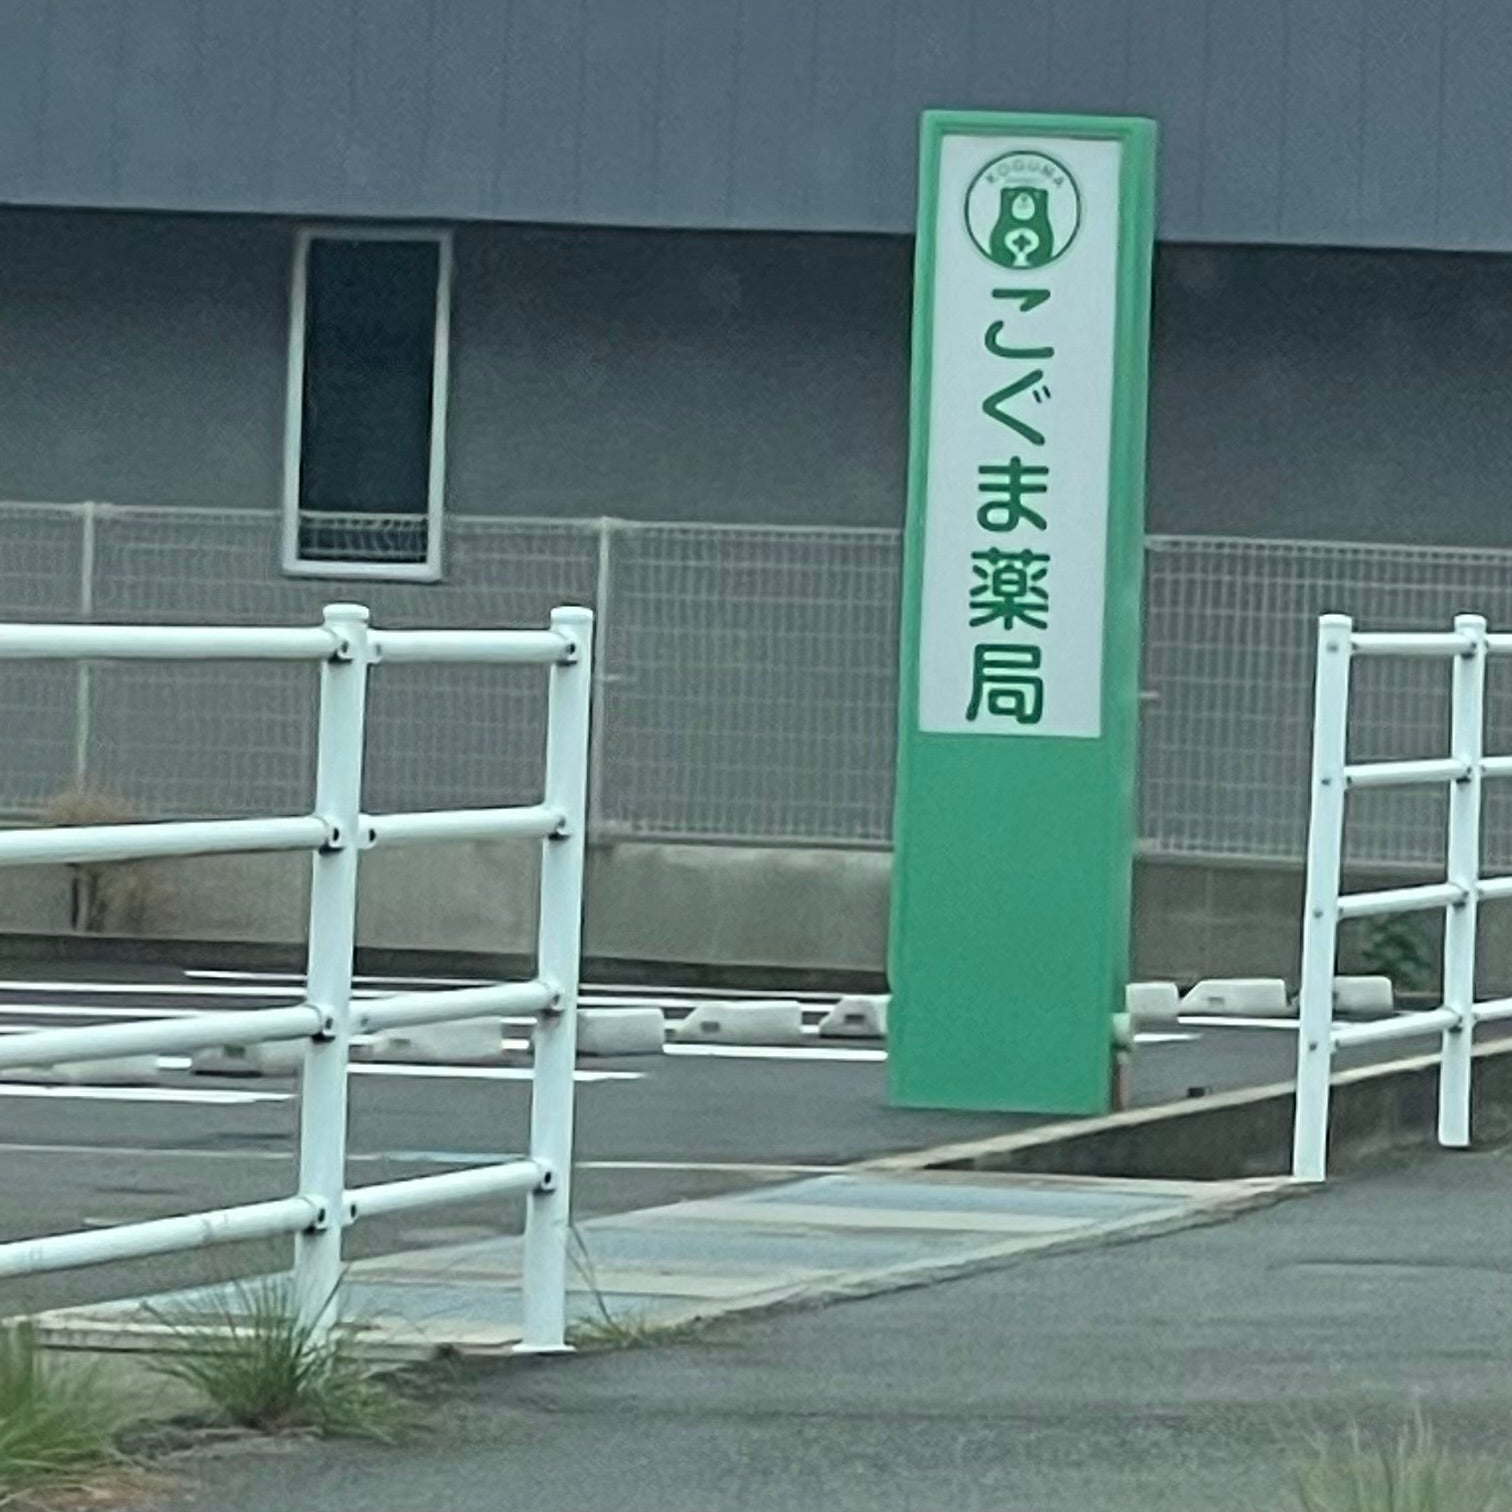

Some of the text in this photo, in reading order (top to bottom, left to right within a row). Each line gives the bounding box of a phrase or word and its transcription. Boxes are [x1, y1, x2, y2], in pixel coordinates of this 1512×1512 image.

[985, 158, 1064, 188] KOGUMA
[966, 287, 1055, 725] こぐま薬局
